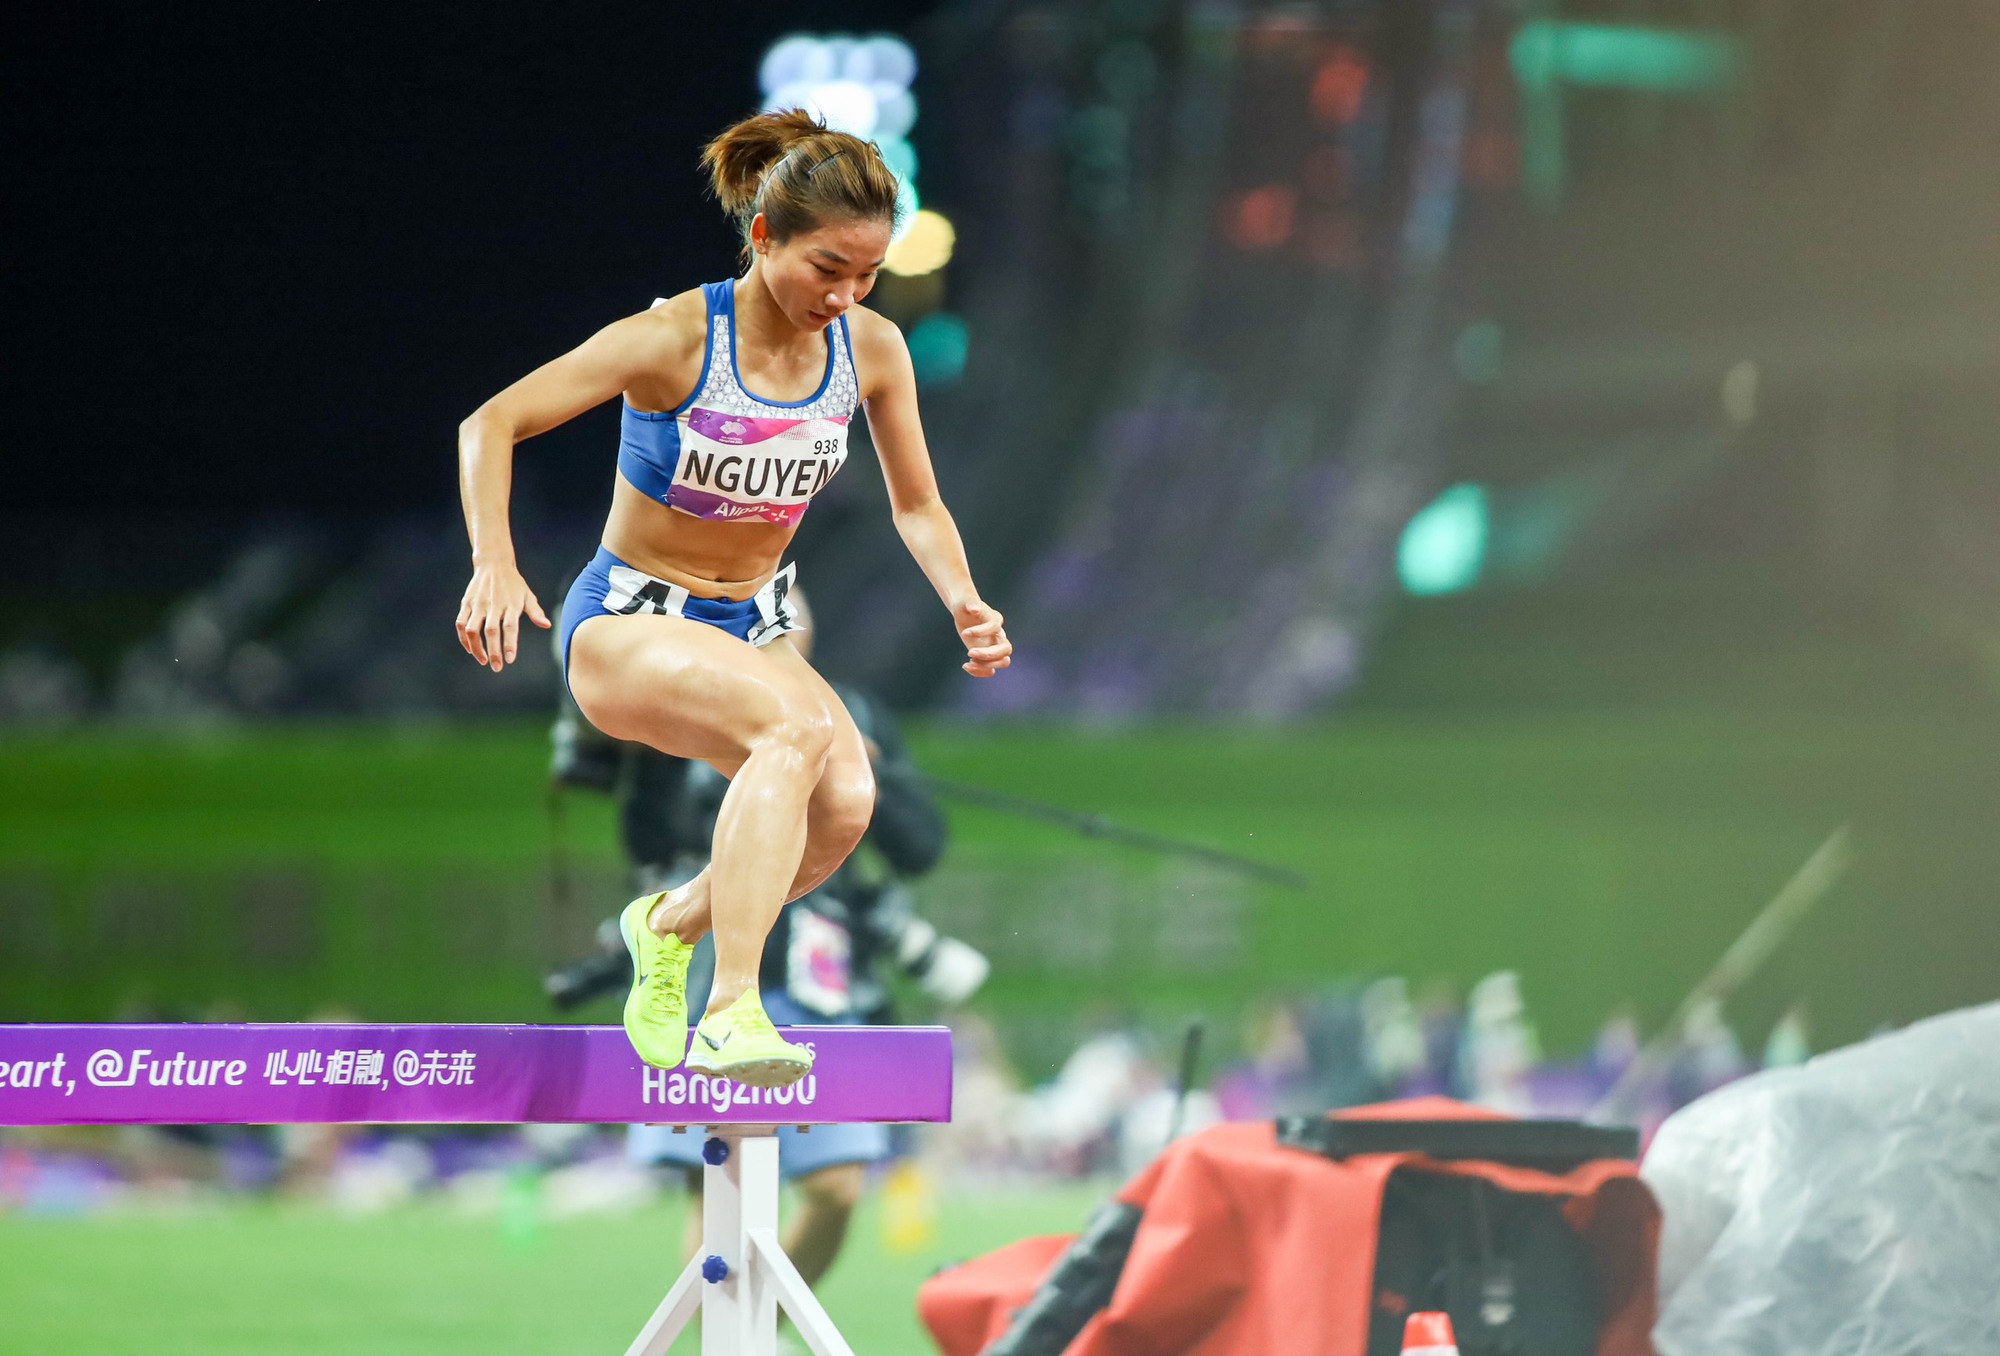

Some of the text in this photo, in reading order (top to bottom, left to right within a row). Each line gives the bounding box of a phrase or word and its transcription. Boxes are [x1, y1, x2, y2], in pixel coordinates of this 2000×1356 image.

[814, 439, 838, 455] 938
[682, 449, 839, 497] NGUYEN
[86, 1049, 247, 1087] @Future
